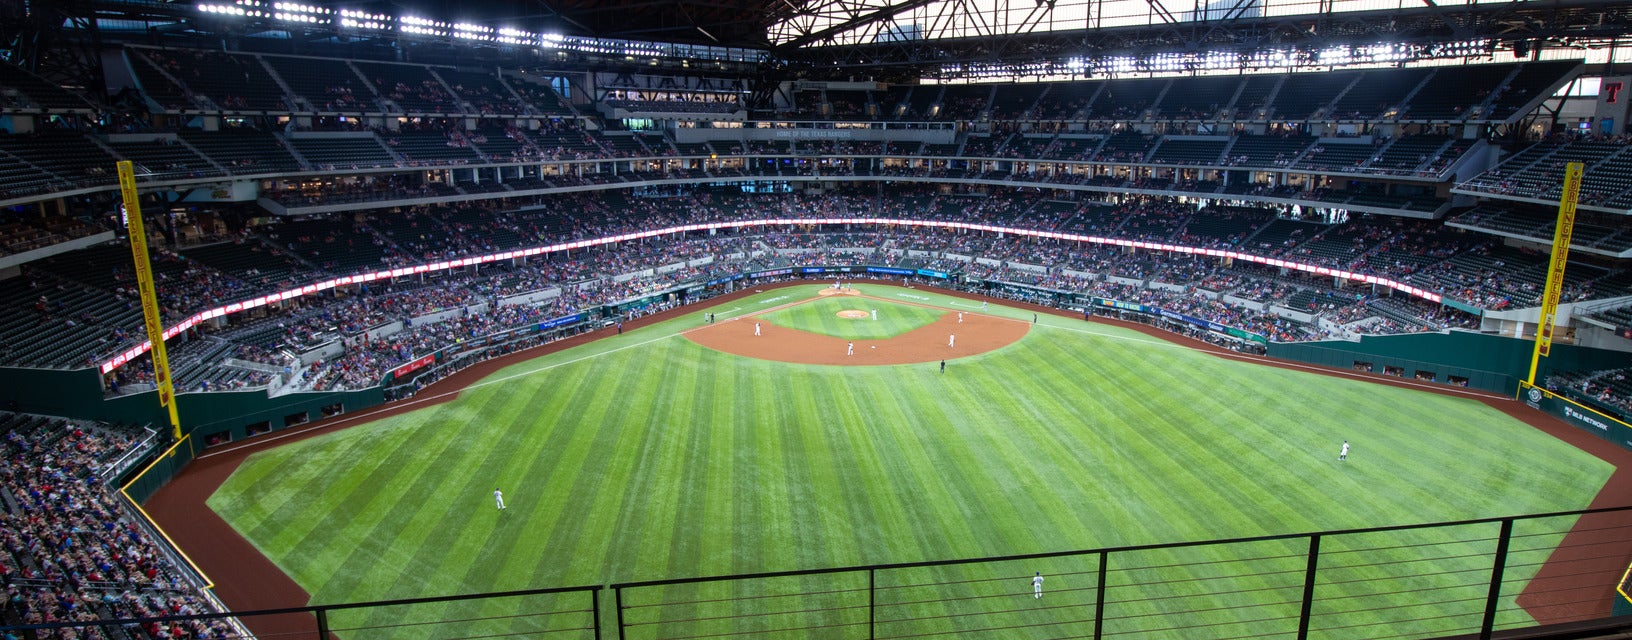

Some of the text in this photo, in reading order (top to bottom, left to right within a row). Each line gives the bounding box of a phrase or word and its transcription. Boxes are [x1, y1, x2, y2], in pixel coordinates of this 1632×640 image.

[1605, 82, 1624, 104] T
[1547, 180, 1578, 315] BRING THE HEAT
[1572, 411, 1609, 431] MLB NETWORK
